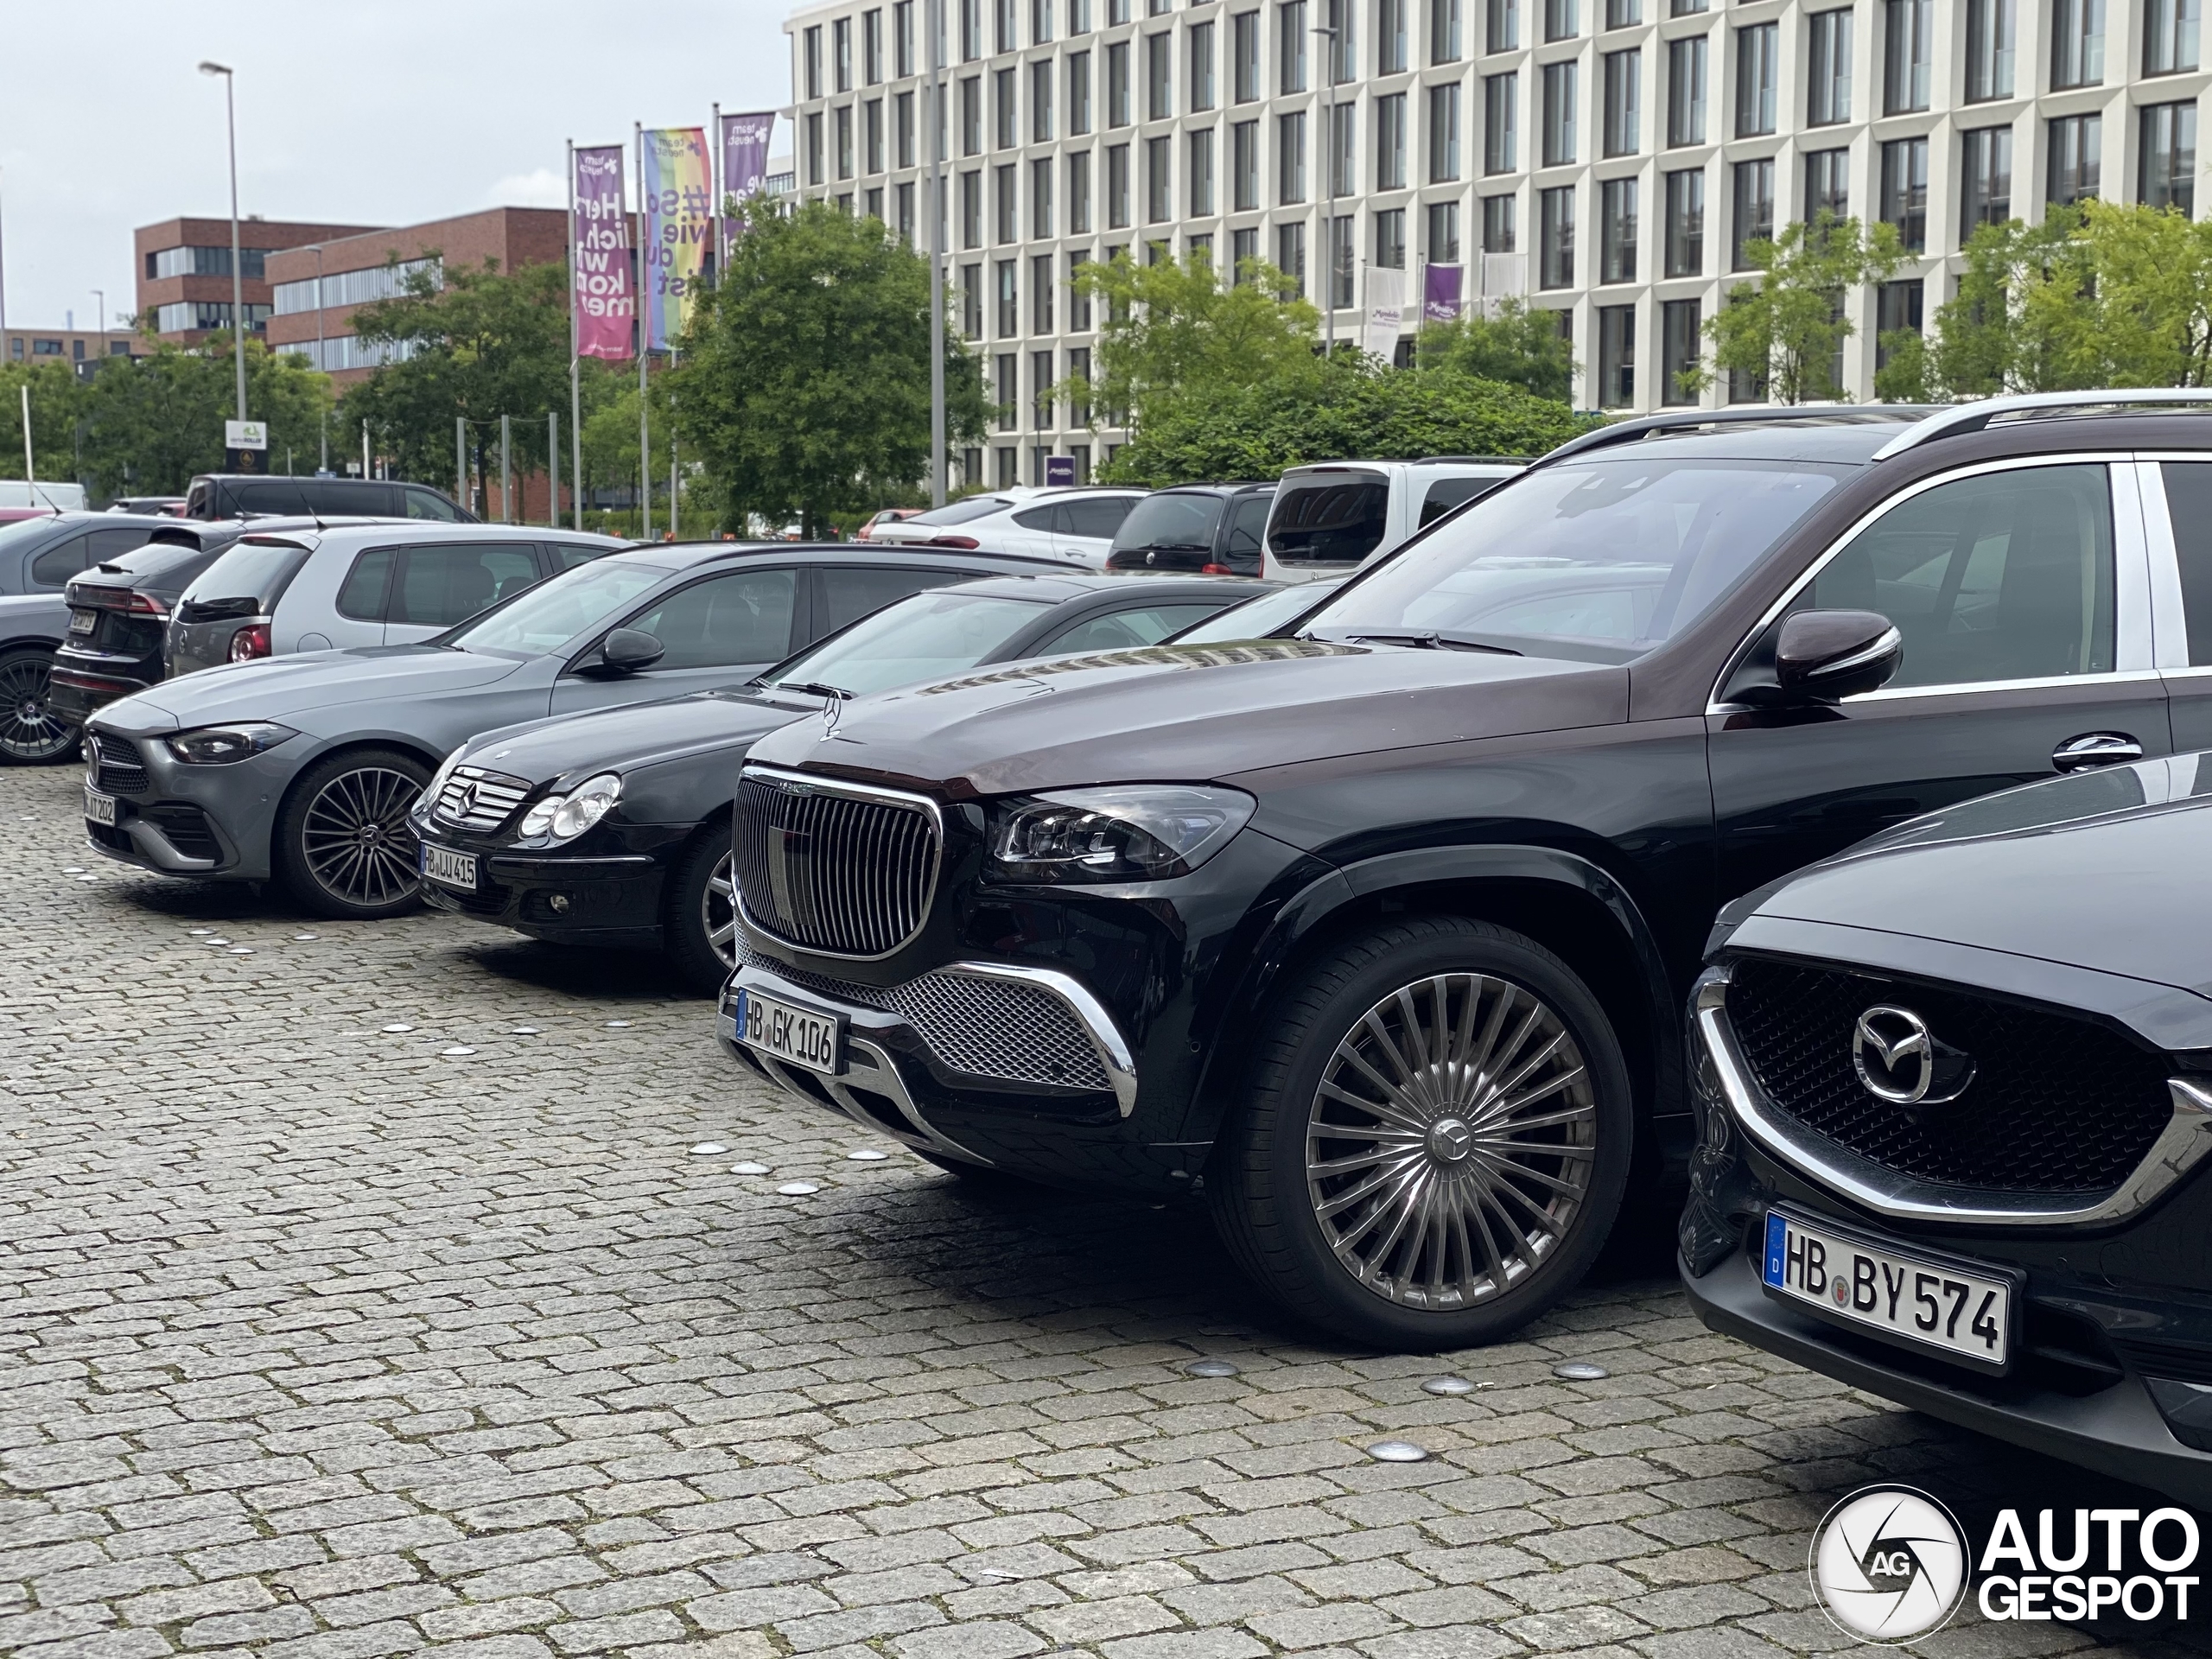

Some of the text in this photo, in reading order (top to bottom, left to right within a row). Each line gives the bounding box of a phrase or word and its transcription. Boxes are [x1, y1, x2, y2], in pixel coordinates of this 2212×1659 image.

[424, 847, 474, 884] HB LU 415
[745, 997, 831, 1065] HB GK 106
[1785, 1230, 1999, 1350] HB BY 574
